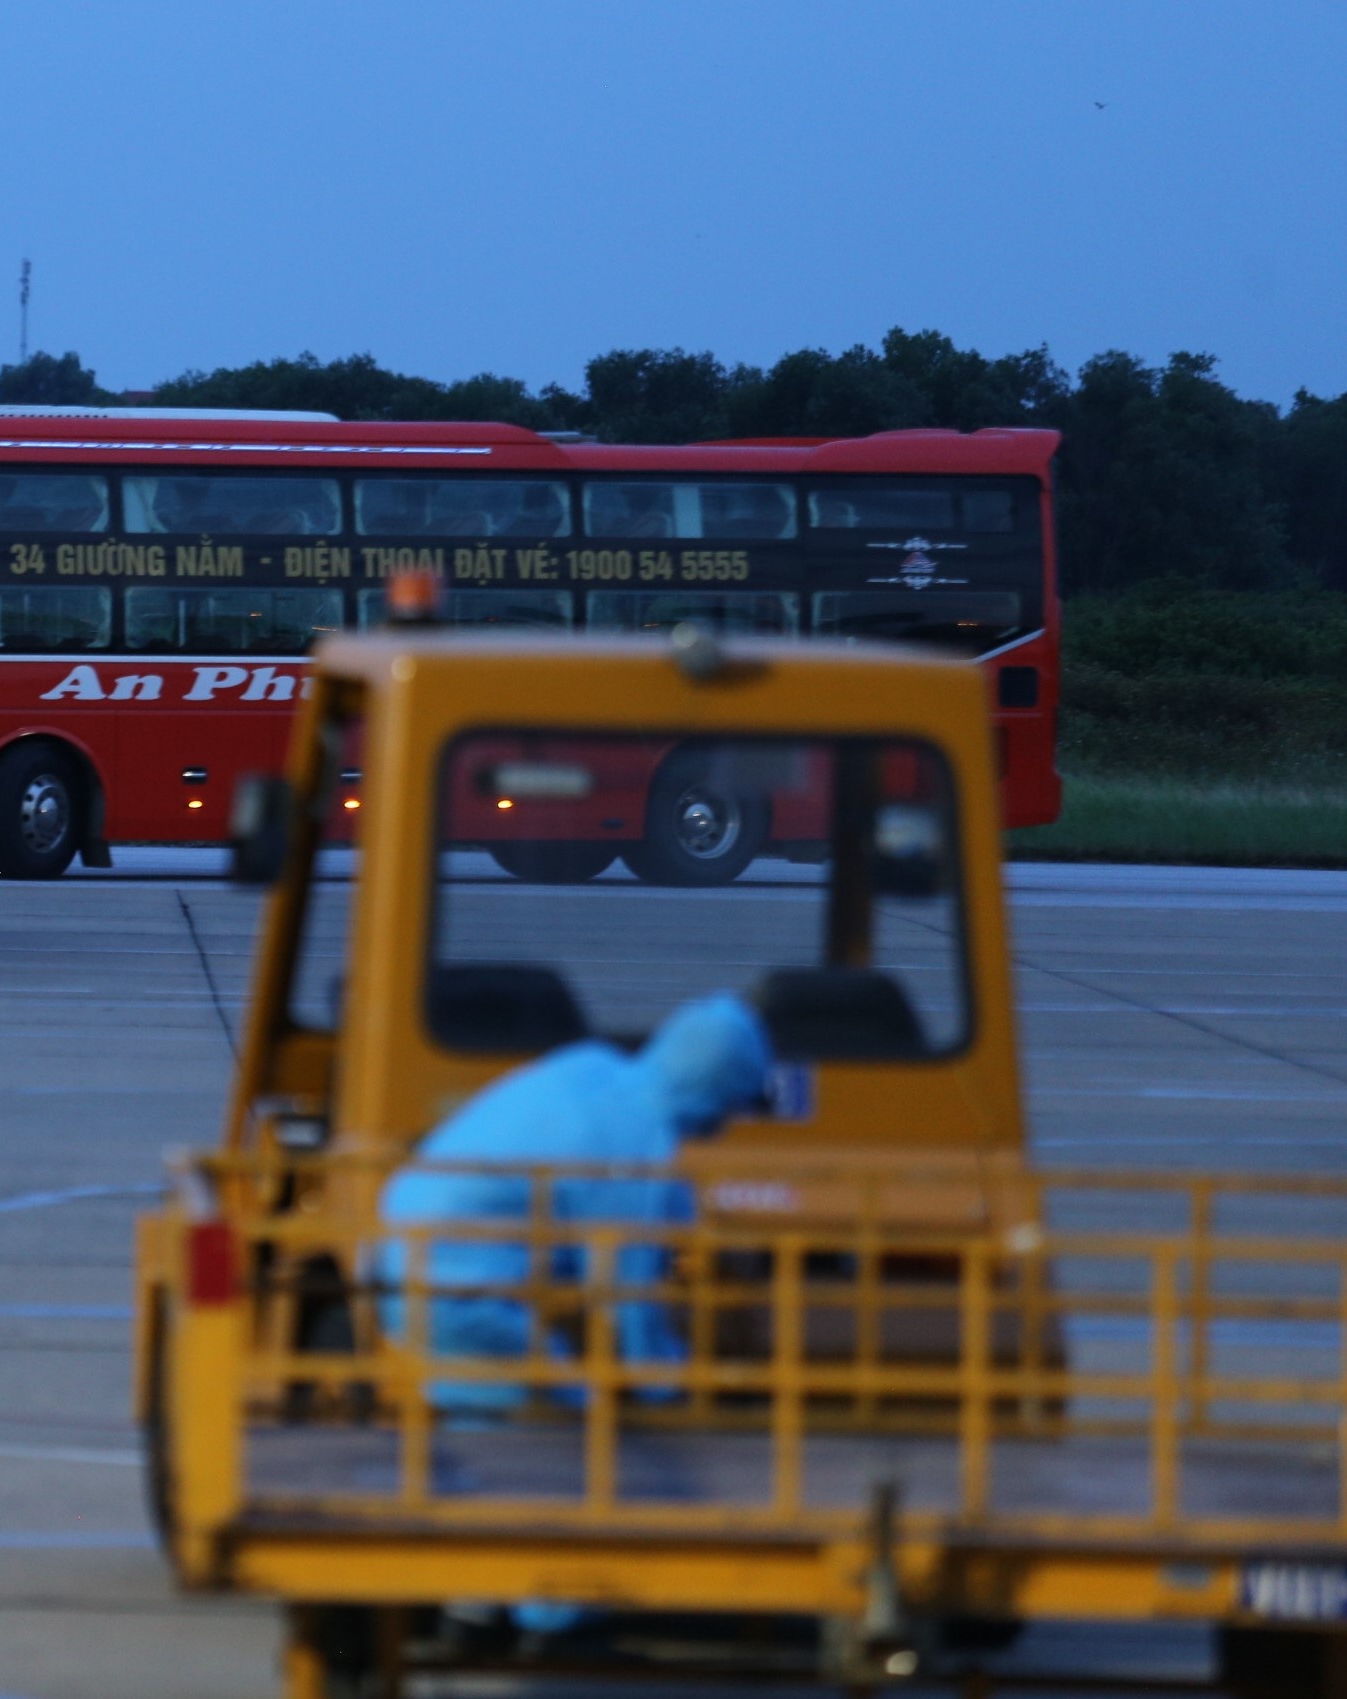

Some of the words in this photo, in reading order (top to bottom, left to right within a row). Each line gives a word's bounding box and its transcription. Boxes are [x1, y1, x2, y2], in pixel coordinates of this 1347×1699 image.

[10, 543, 45, 575] 34
[57, 537, 166, 576] GIƯỜNG
[284, 540, 351, 585] ĐIỆN
[454, 543, 507, 585] ĐẶT
[516, 542, 558, 580] VÉ:
[566, 551, 631, 580] 1900
[639, 551, 672, 581] 54
[681, 551, 748, 581] 5555
[39, 665, 162, 700] An
